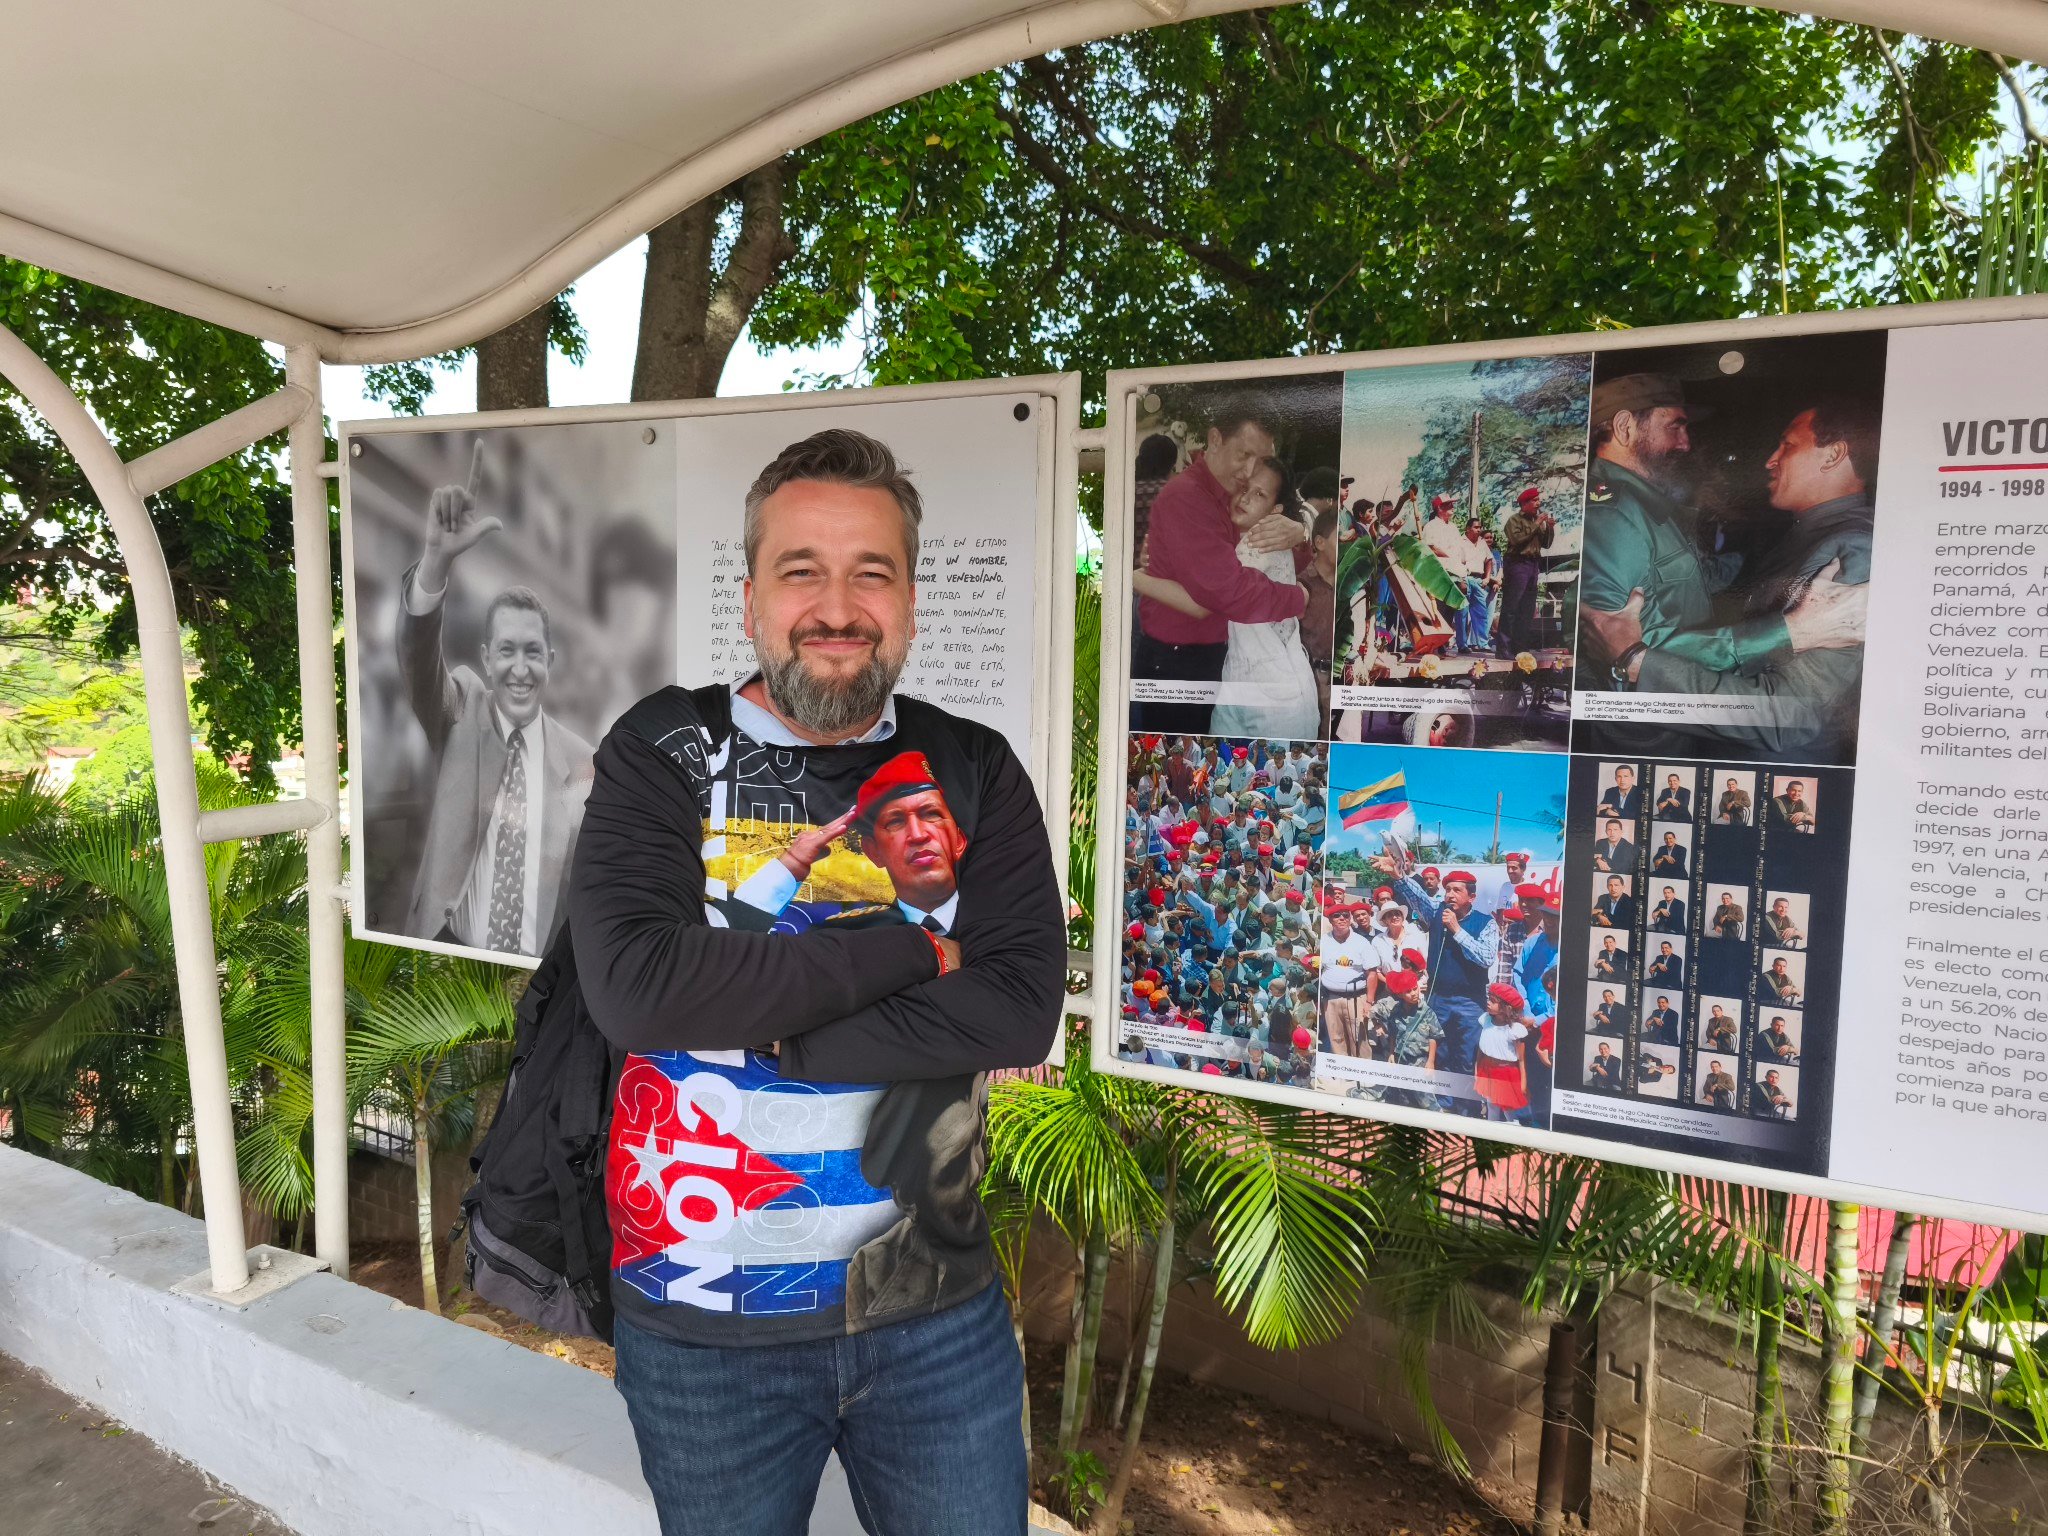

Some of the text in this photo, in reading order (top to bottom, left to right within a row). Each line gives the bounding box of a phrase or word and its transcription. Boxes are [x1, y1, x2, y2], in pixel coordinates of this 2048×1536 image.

[1943, 418, 2048, 456] VICTO
[1940, 481, 1982, 498] 1994
[2002, 479, 2045, 497] 1998
[1937, 523, 1987, 536] Entre
[923, 535, 946, 548] ESTÁ
[953, 537, 966, 547] EN
[975, 537, 1007, 547] ESTADO
[1935, 542, 2036, 559] emprende
[921, 556, 935, 567] SOY
[946, 555, 959, 565] UN
[968, 555, 1008, 567] HOMBRE,
[1934, 562, 2028, 576] recorridos
[712, 574, 725, 584] SOY
[733, 572, 745, 583] UN
[711, 588, 736, 599] ANTES
[927, 591, 961, 601] ESTABA
[972, 590, 985, 600] EN
[1933, 583, 2016, 598] Panamá,
[953, 607, 1007, 619] DOMINANTE,
[1930, 603, 2026, 617] diciembre
[711, 622, 729, 631] PUES
[939, 624, 952, 634] NO
[961, 622, 1006, 635] TENÍAMOS
[1929, 623, 1997, 637] Chávez
[711, 638, 730, 647] OTRA
[921, 642, 935, 652] EN
[982, 643, 1005, 653] ANDO
[1928, 643, 2028, 658] Venezuela.
[711, 652, 722, 662] EN
[954, 661, 971, 670] QUE
[1926, 663, 1993, 679] política
[2005, 668, 2017, 681] y
[991, 678, 1005, 688] EN
[1924, 683, 2014, 700] siguiente,
[1923, 703, 2026, 719] Bolivariana
[1921, 723, 2010, 740] gobierno,
[1920, 742, 2047, 760] militantes del
[1917, 782, 2006, 799] Tomando
[1916, 801, 2041, 821] decide darle
[1915, 820, 1991, 838] intensas
[1913, 840, 1955, 857] 1997,
[1962, 846, 1986, 857] en
[1995, 848, 2030, 861] una
[1911, 862, 2030, 883] en Valencia,
[1910, 881, 1977, 898] escoge
[1995, 888, 2006, 899] a
[1909, 900, 2041, 922] presidenciales
[1907, 937, 2011, 959] Finalmente
[2017, 948, 2033, 961] el
[1904, 958, 2048, 982] es electo com
[1903, 975, 2041, 1001] Venezuela, con
[1902, 996, 1912, 1007] a
[1920, 998, 1943, 1011] un
[1950, 1000, 2017, 1019] 56.20%
[1901, 1013, 1982, 1035] Proyecto
[1899, 1033, 2045, 1062] despejado para
[1898, 1052, 1955, 1071] tantos
[1966, 1061, 2011, 1078] años
[1896, 1072, 1985, 1094] comienza
[1991, 1084, 2032, 1100] para
[1895, 1091, 2048, 1122] por la que ahora
